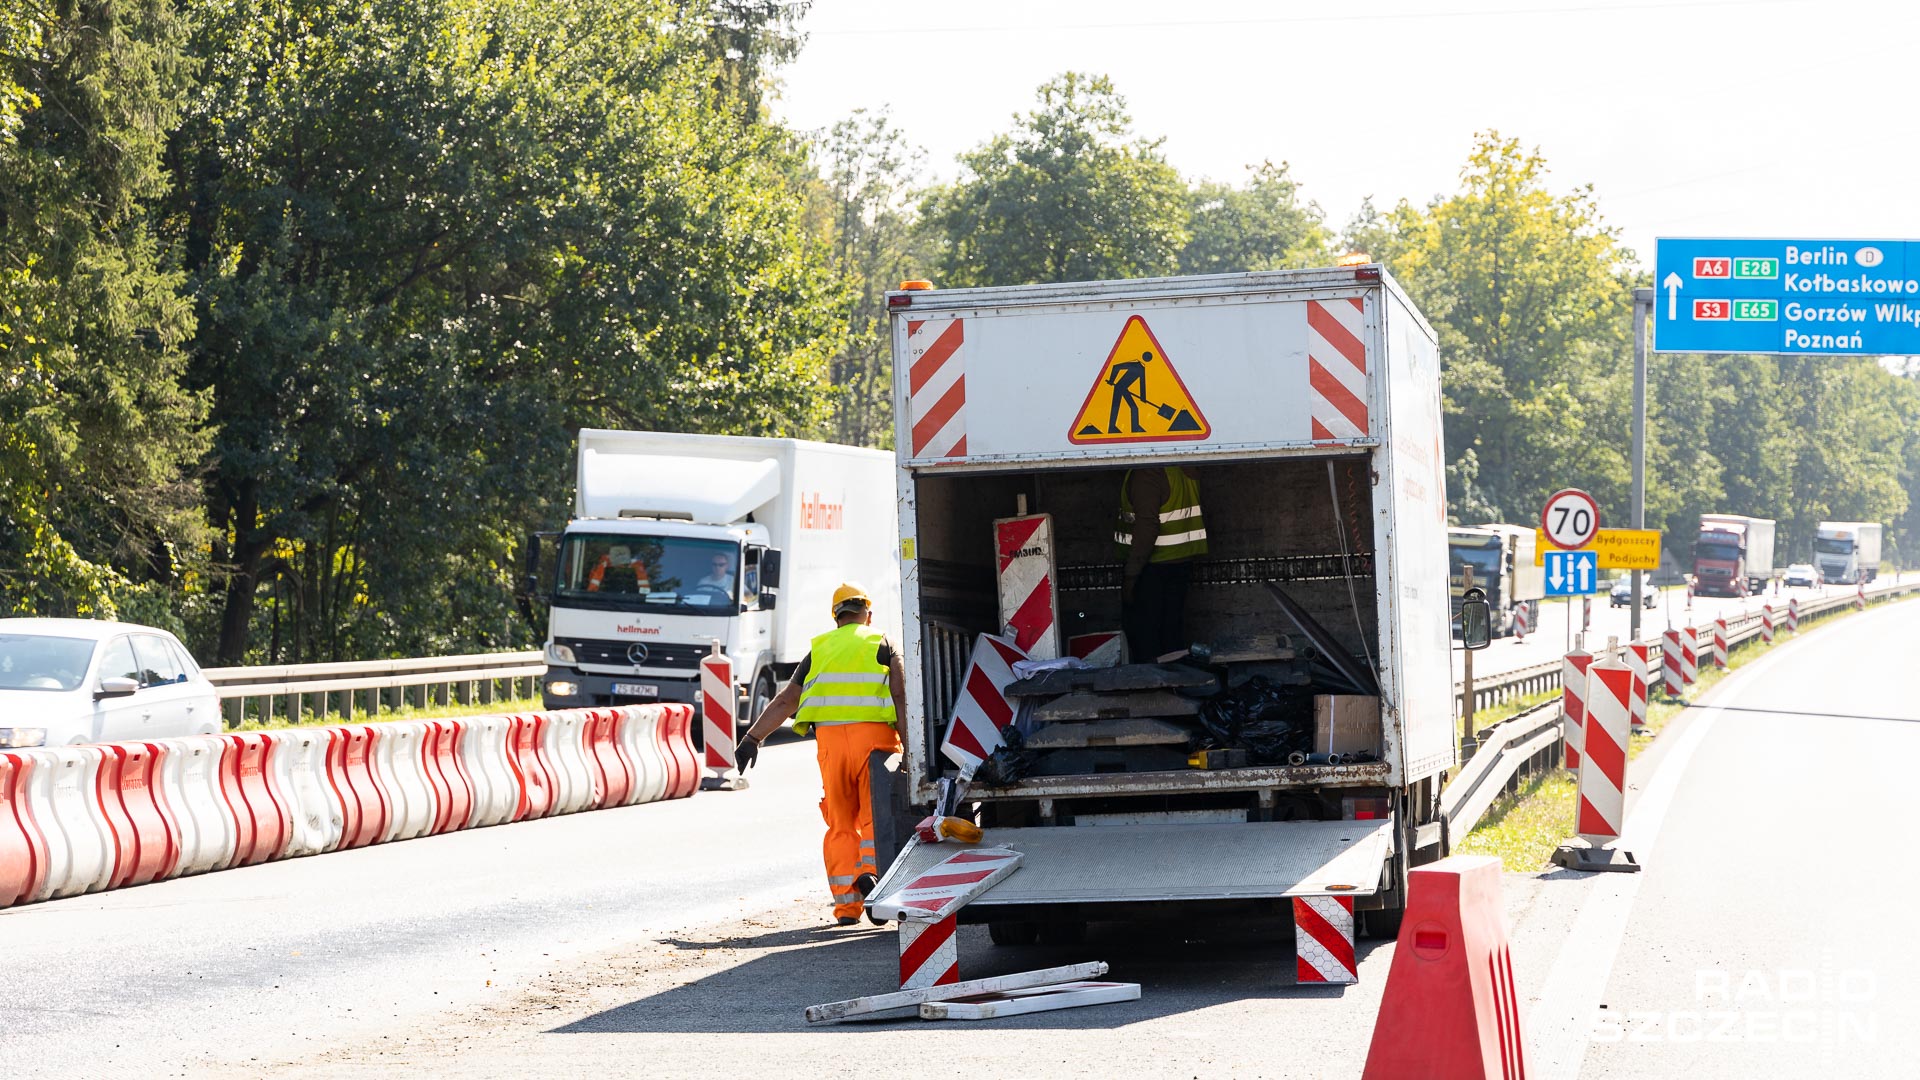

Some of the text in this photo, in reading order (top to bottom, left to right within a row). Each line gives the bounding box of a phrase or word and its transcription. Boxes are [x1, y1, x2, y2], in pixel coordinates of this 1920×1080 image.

[1785, 245, 1875, 265] Berlin D
[1701, 260, 1771, 276] A6 E28
[1784, 272, 1920, 294] Kołbaskowo
[1701, 302, 1770, 318] S3 E65
[1784, 302, 1867, 322] Gorzów
[1784, 328, 1863, 349] Poznań
[800, 491, 843, 530] hellmann
[1554, 506, 1591, 537] 70
[1597, 534, 1656, 547] Bydgoszczy
[1609, 552, 1656, 566] Podjuchy
[616, 624, 660, 635] hellmann
